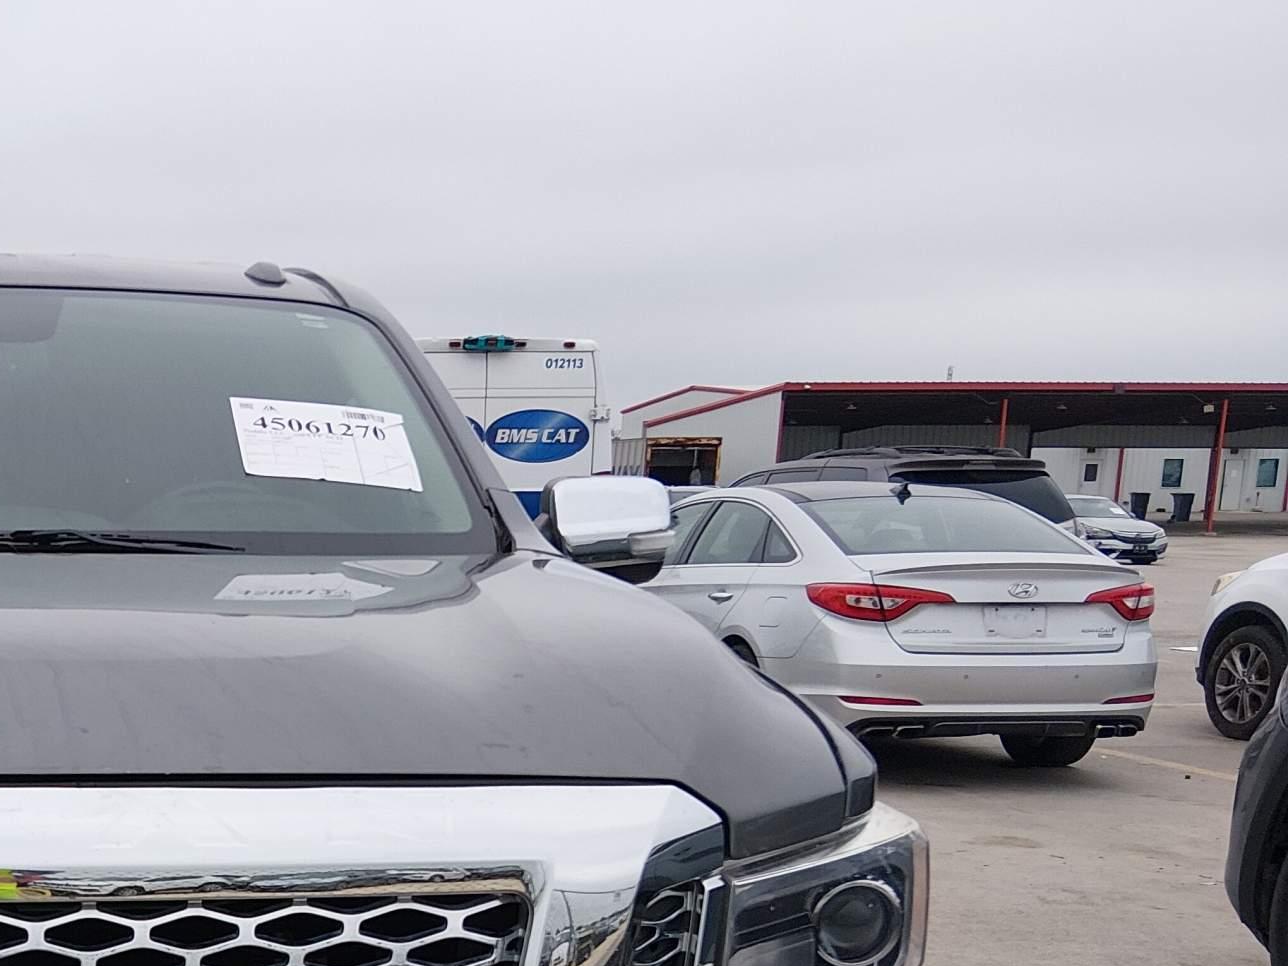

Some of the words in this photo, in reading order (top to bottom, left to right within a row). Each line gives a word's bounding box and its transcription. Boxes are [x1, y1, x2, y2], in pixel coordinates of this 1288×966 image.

[545, 358, 584, 369] 012113
[252, 416, 386, 441] 45061270
[495, 429, 538, 444] BMS
[541, 428, 580, 443] CAT
